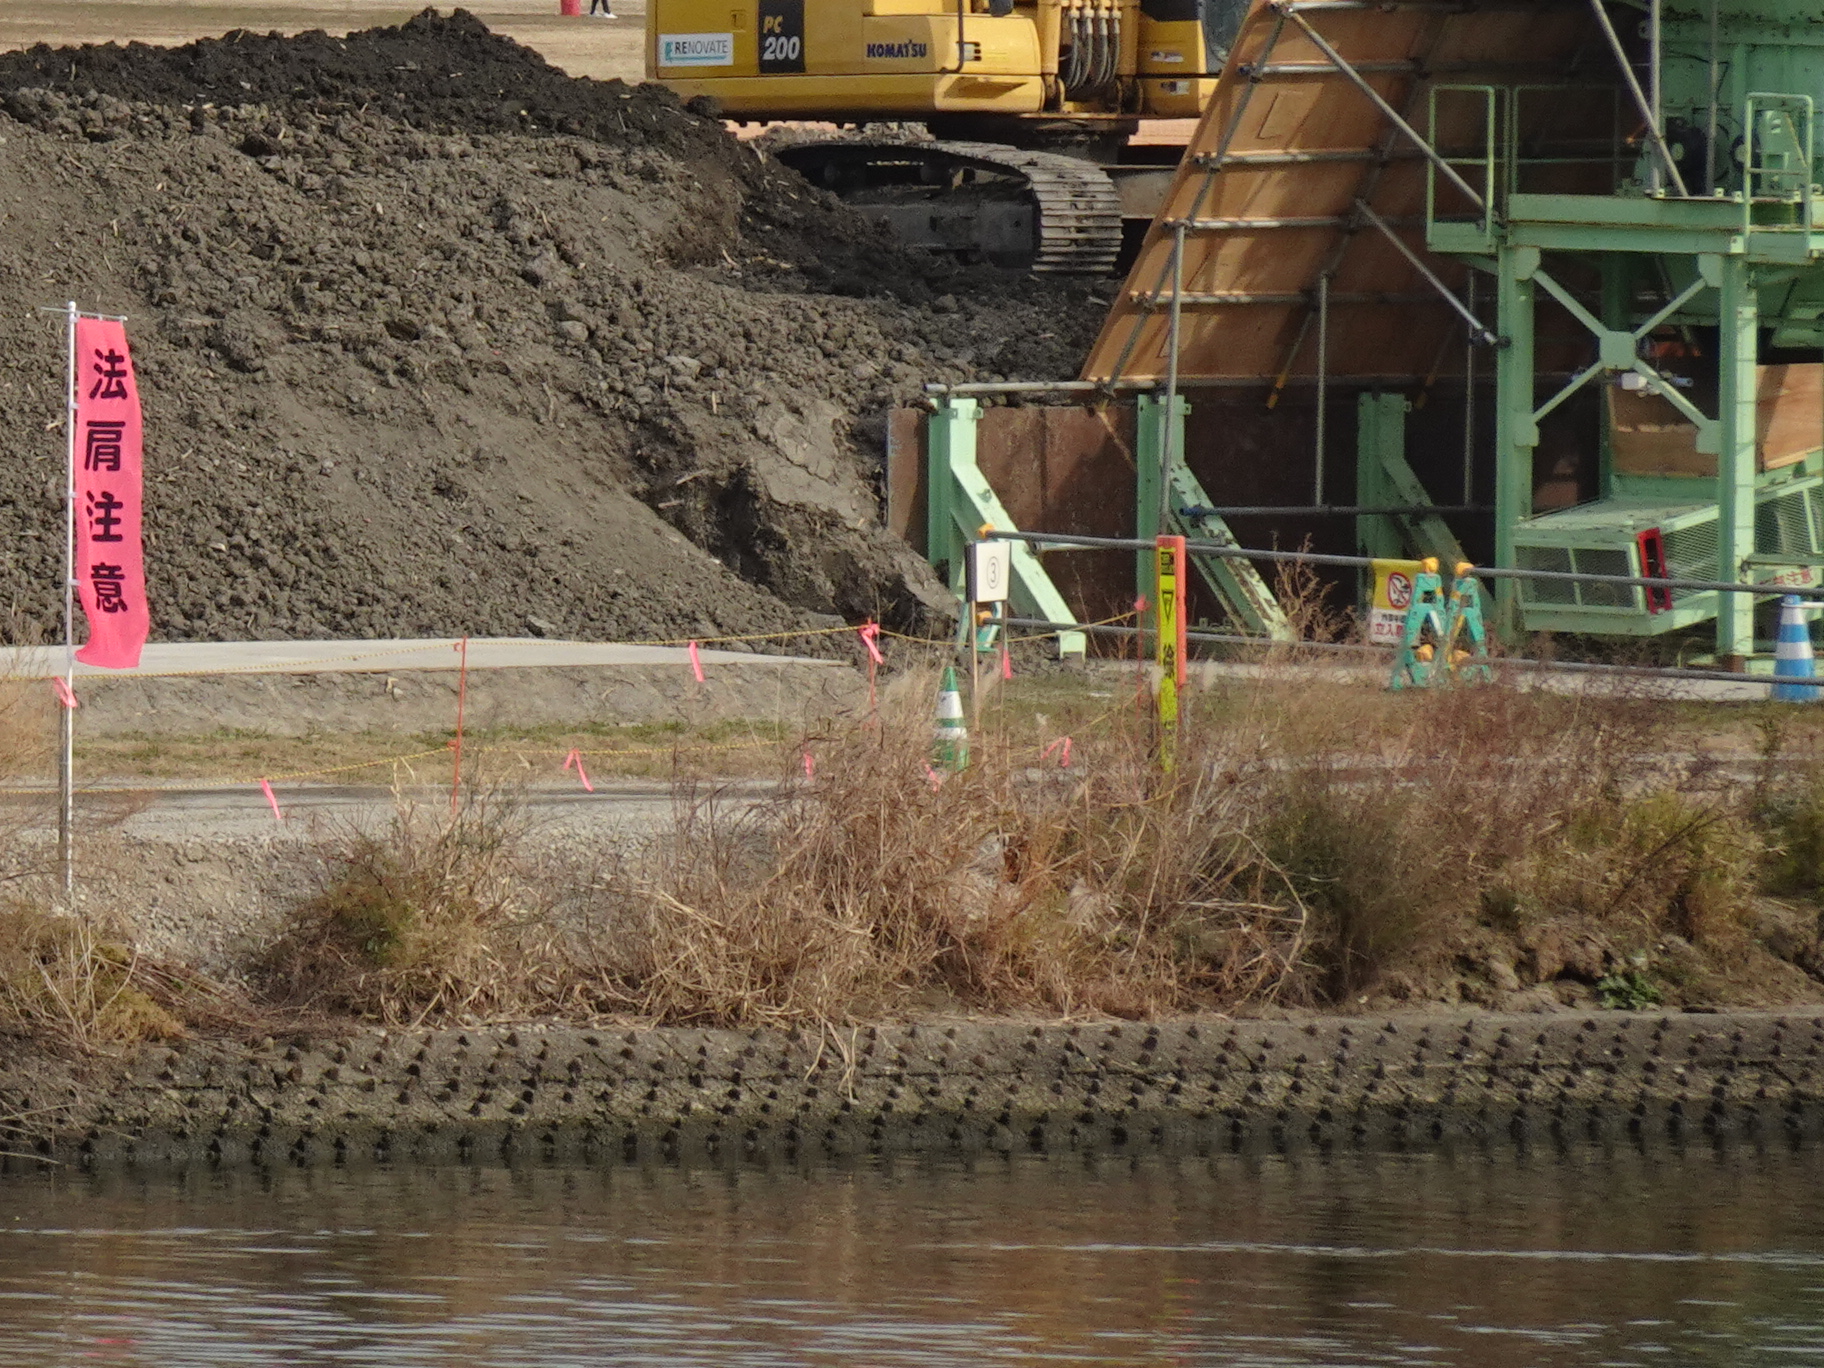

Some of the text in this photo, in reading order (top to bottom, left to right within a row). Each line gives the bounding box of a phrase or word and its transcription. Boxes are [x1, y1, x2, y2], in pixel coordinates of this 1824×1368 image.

[763, 15, 783, 33] PC
[674, 39, 729, 54] RENOVATE
[762, 35, 801, 60] 200
[866, 38, 927, 58] KOMATSU
[84, 348, 128, 613] 法肩注意
